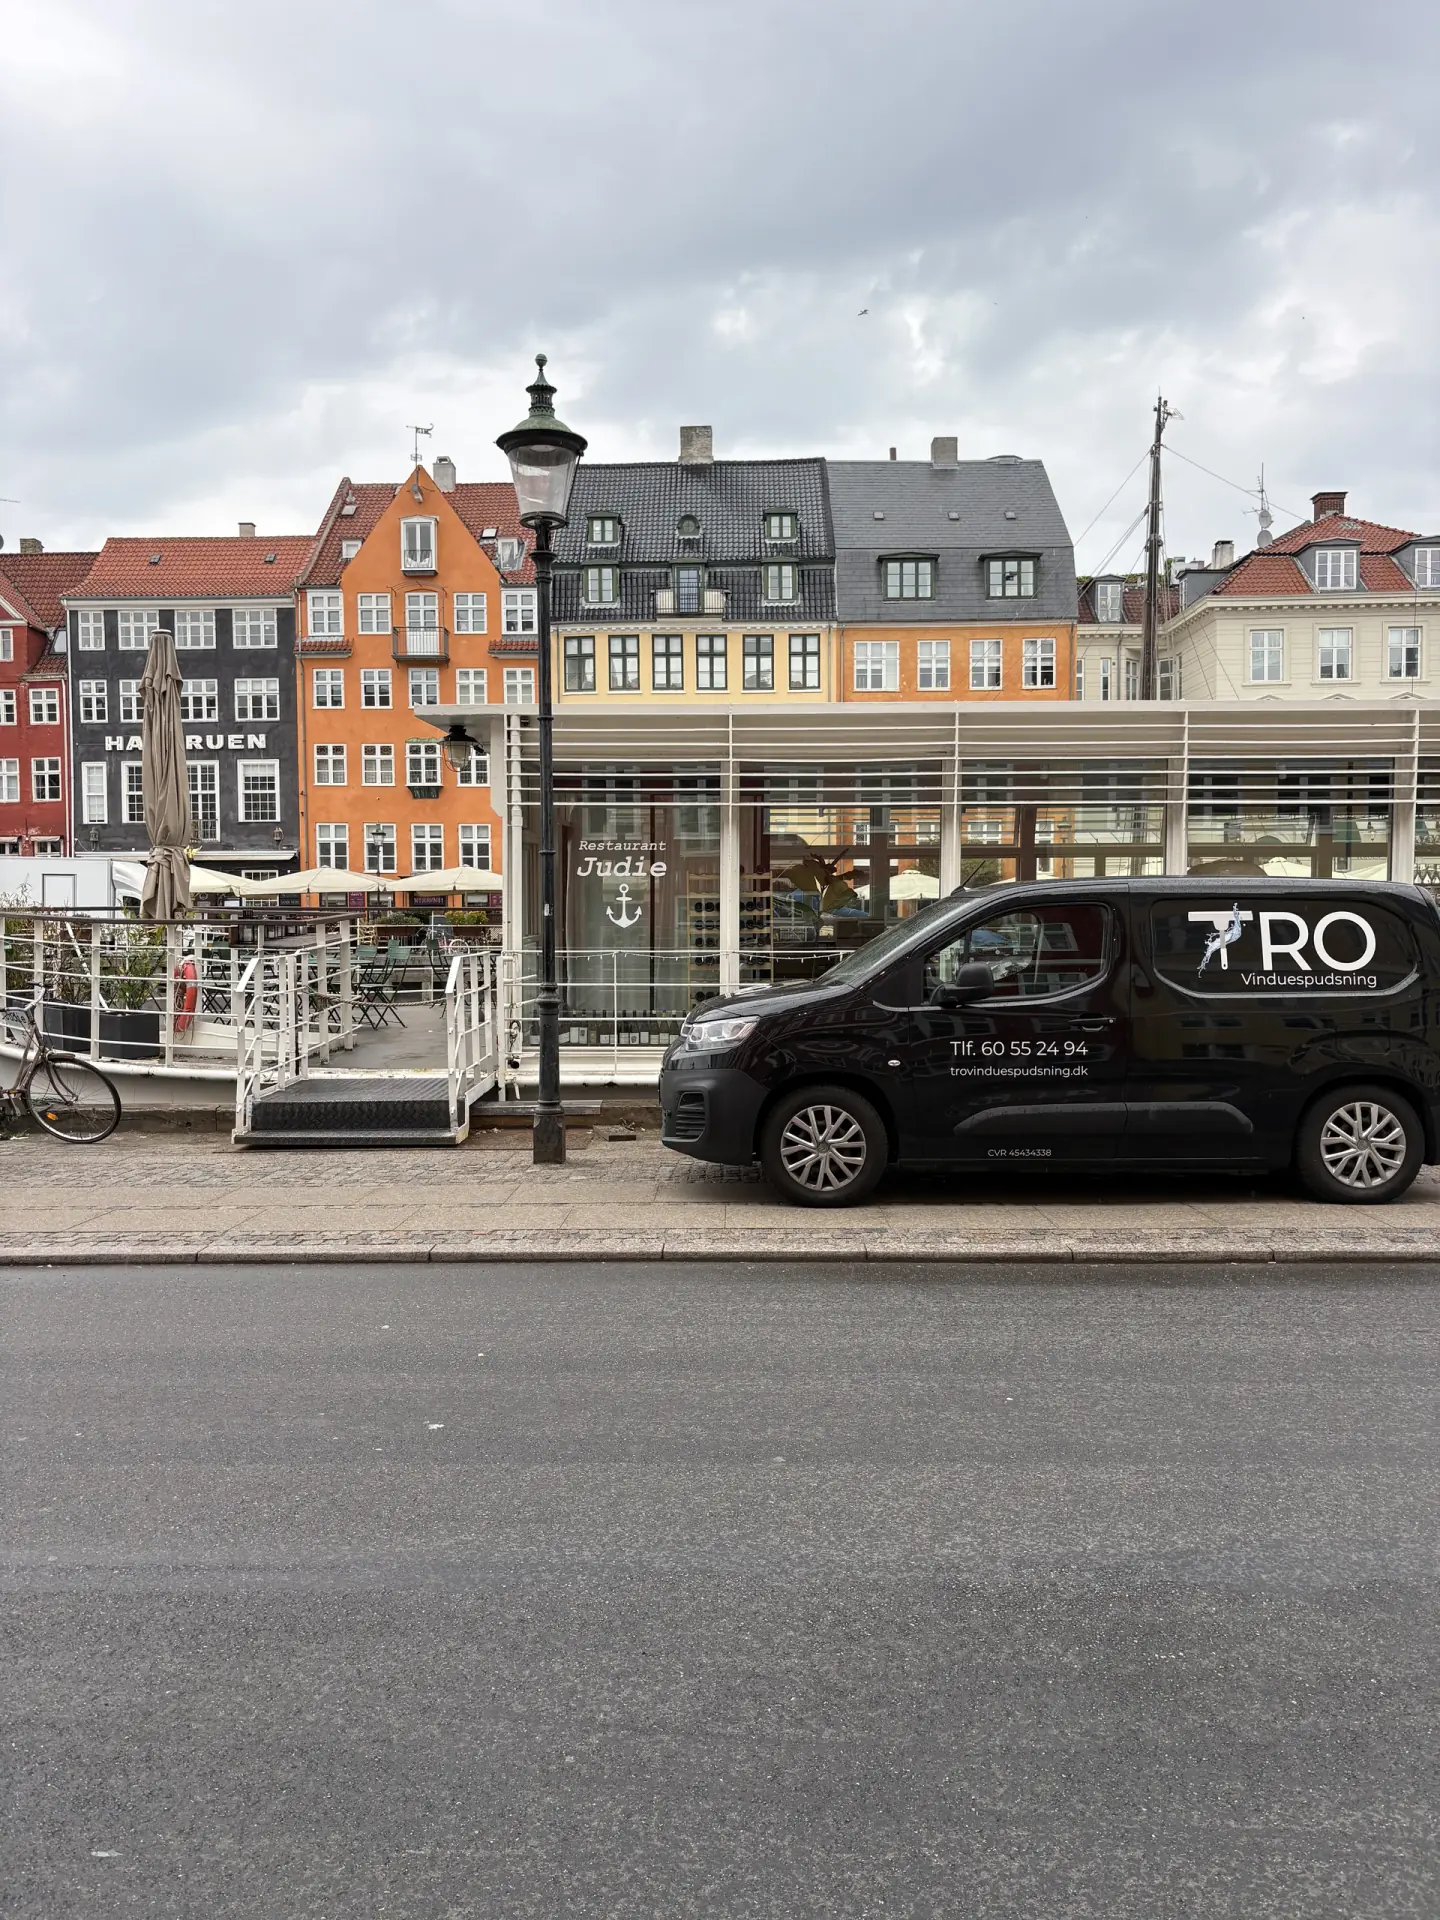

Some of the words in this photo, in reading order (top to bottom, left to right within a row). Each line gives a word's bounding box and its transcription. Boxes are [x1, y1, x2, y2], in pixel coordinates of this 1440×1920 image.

[104, 733, 267, 751] HARUEN
[578, 840, 667, 851] Restaurant
[576, 855, 667, 877] Judie
[1187, 910, 1376, 971] TRO
[1240, 972, 1377, 988] Vinduespudsning
[949, 1040, 976, 1056] Tlf.
[981, 1041, 1005, 1056] 60
[1009, 1041, 1031, 1056] 55
[1036, 1041, 1059, 1056] 24
[1063, 1041, 1088, 1056] 94
[950, 1065, 1088, 1078] trovinduespudsning.dk
[987, 1149, 1007, 1157] CVR
[1009, 1148, 1052, 1157] 45434338
